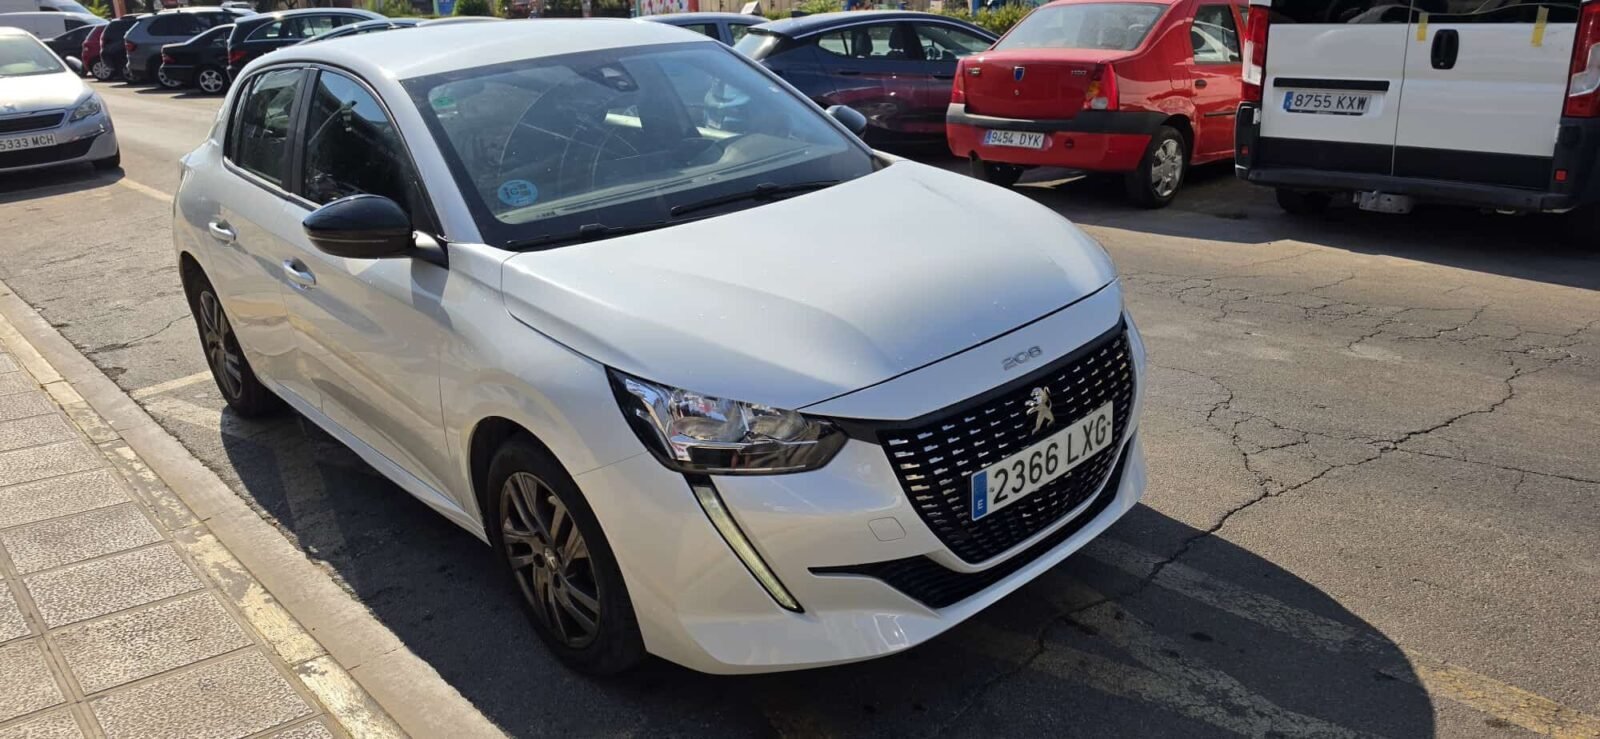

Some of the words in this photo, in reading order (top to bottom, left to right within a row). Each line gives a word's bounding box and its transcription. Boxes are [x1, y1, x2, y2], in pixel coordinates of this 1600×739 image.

[1294, 94, 1332, 108] 8755
[1336, 95, 1367, 111] KXW
[0, 137, 29, 150] 5333
[32, 134, 55, 146] MCH
[991, 131, 1014, 144] 9454
[1019, 132, 1041, 147] DYK
[1001, 345, 1043, 371] 208
[993, 442, 1059, 505] 2366
[1067, 414, 1107, 465] LXG
